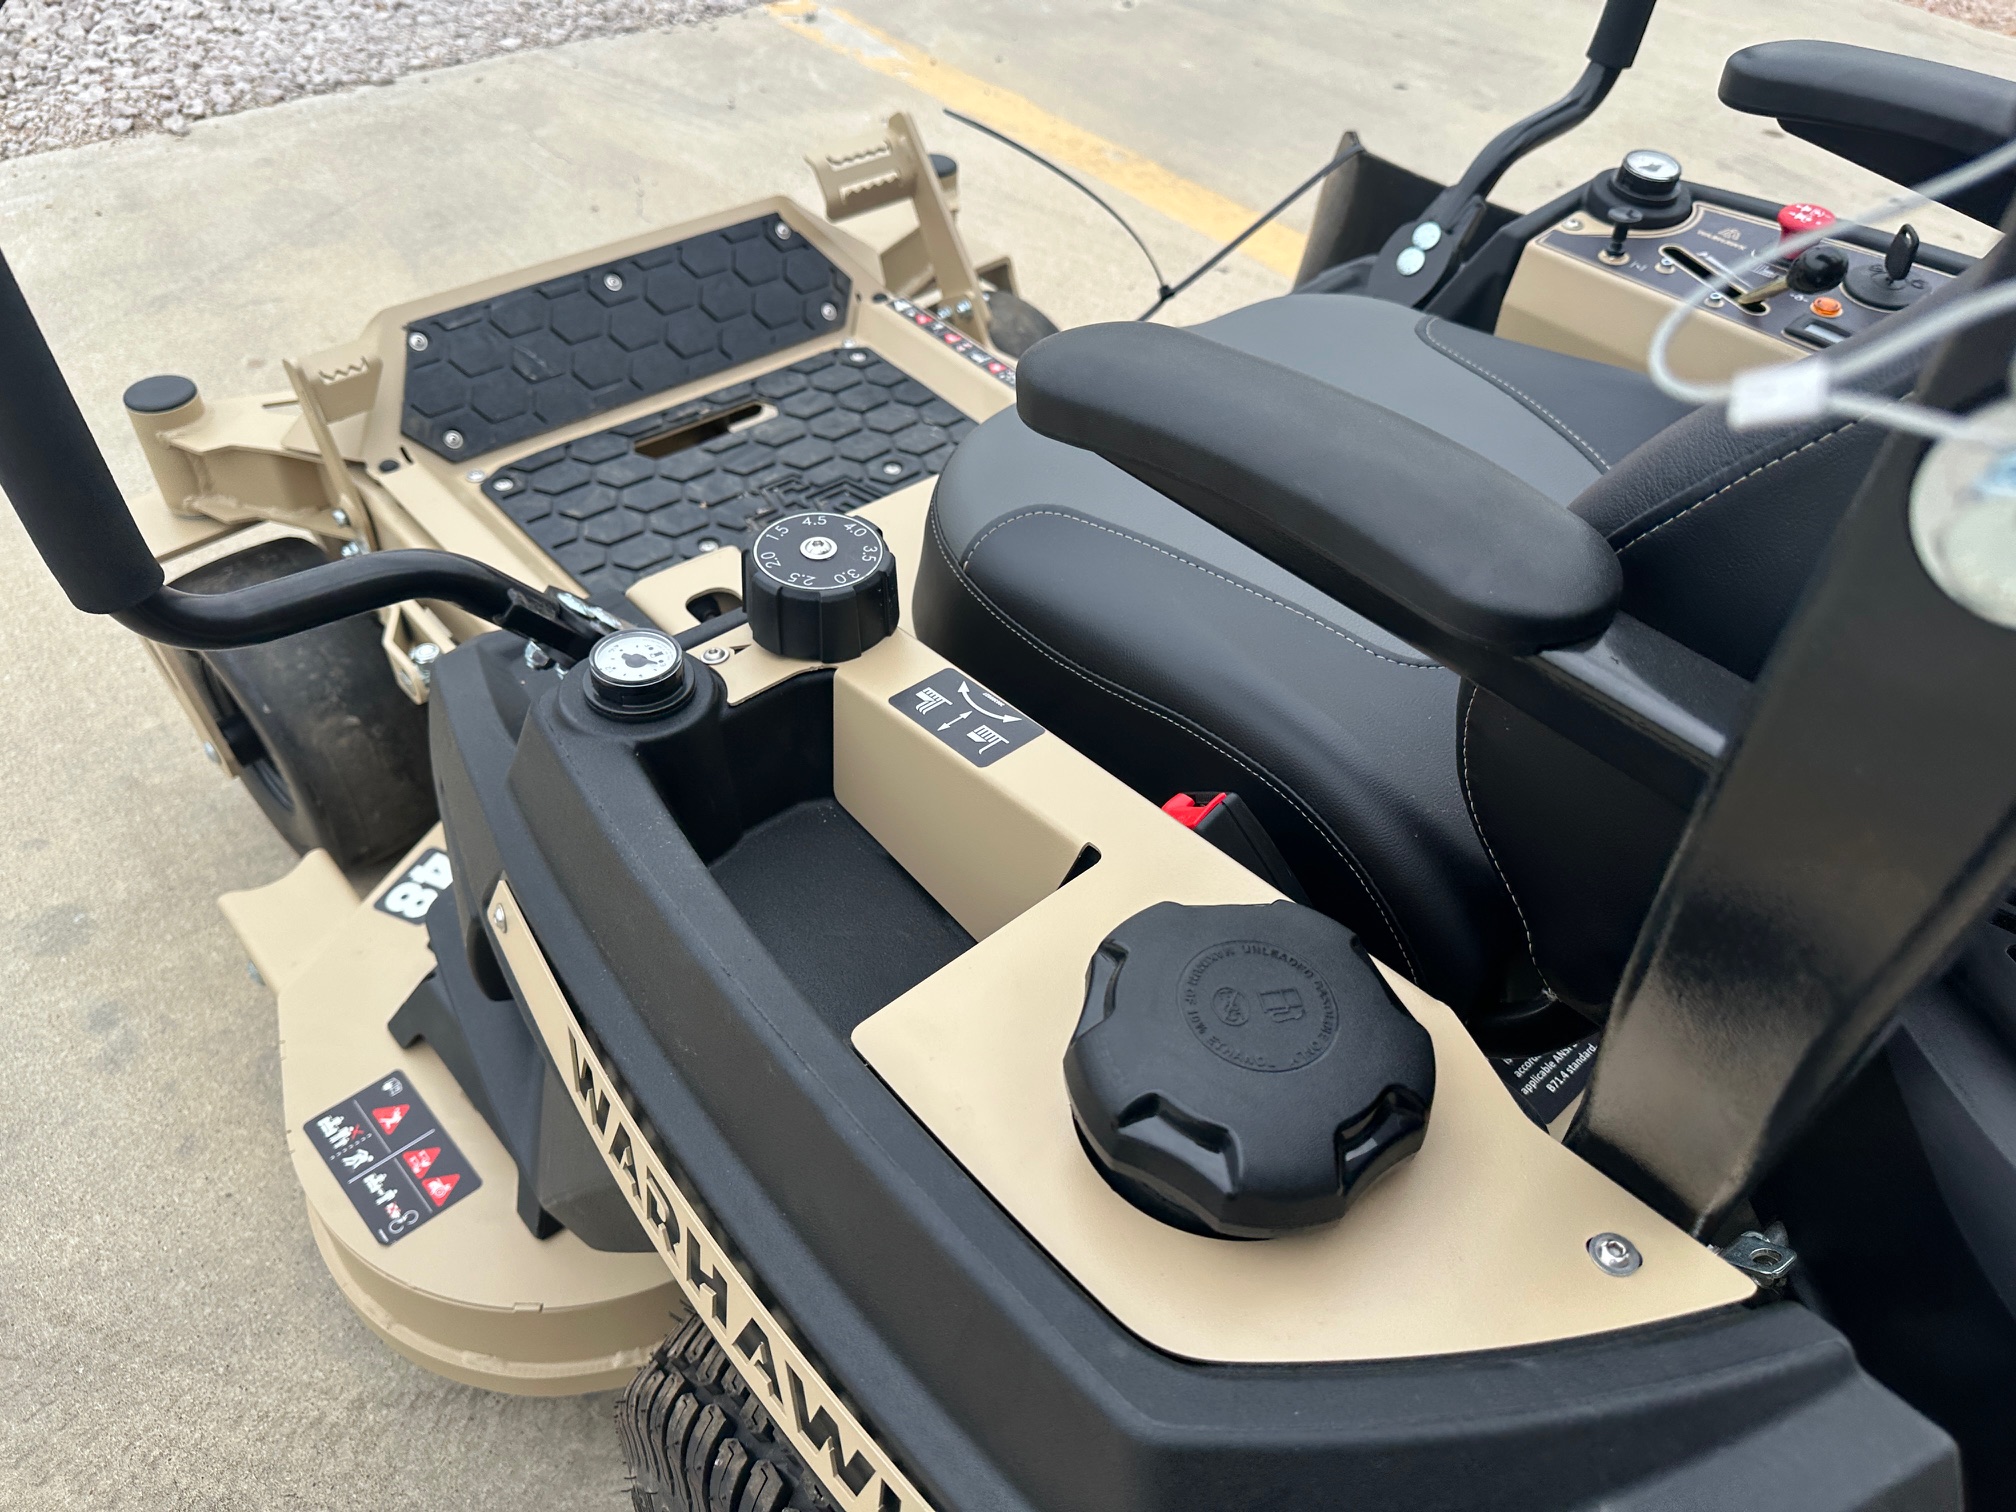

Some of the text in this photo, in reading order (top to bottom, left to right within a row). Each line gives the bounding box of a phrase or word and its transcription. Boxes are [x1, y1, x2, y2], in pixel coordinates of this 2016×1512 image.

[802, 515, 827, 525] 4.5
[766, 525, 789, 541] 1.5
[843, 522, 867, 537] 4.0
[760, 551, 782, 569] 2.0
[861, 545, 878, 562] 3.5
[788, 572, 816, 586] 2.5
[833, 568, 860, 584] 3.0
[1545, 1043, 1598, 1093] B71.4 standard.
[1521, 1060, 1557, 1095] applicable
[569, 1026, 902, 1512] WARHAW
